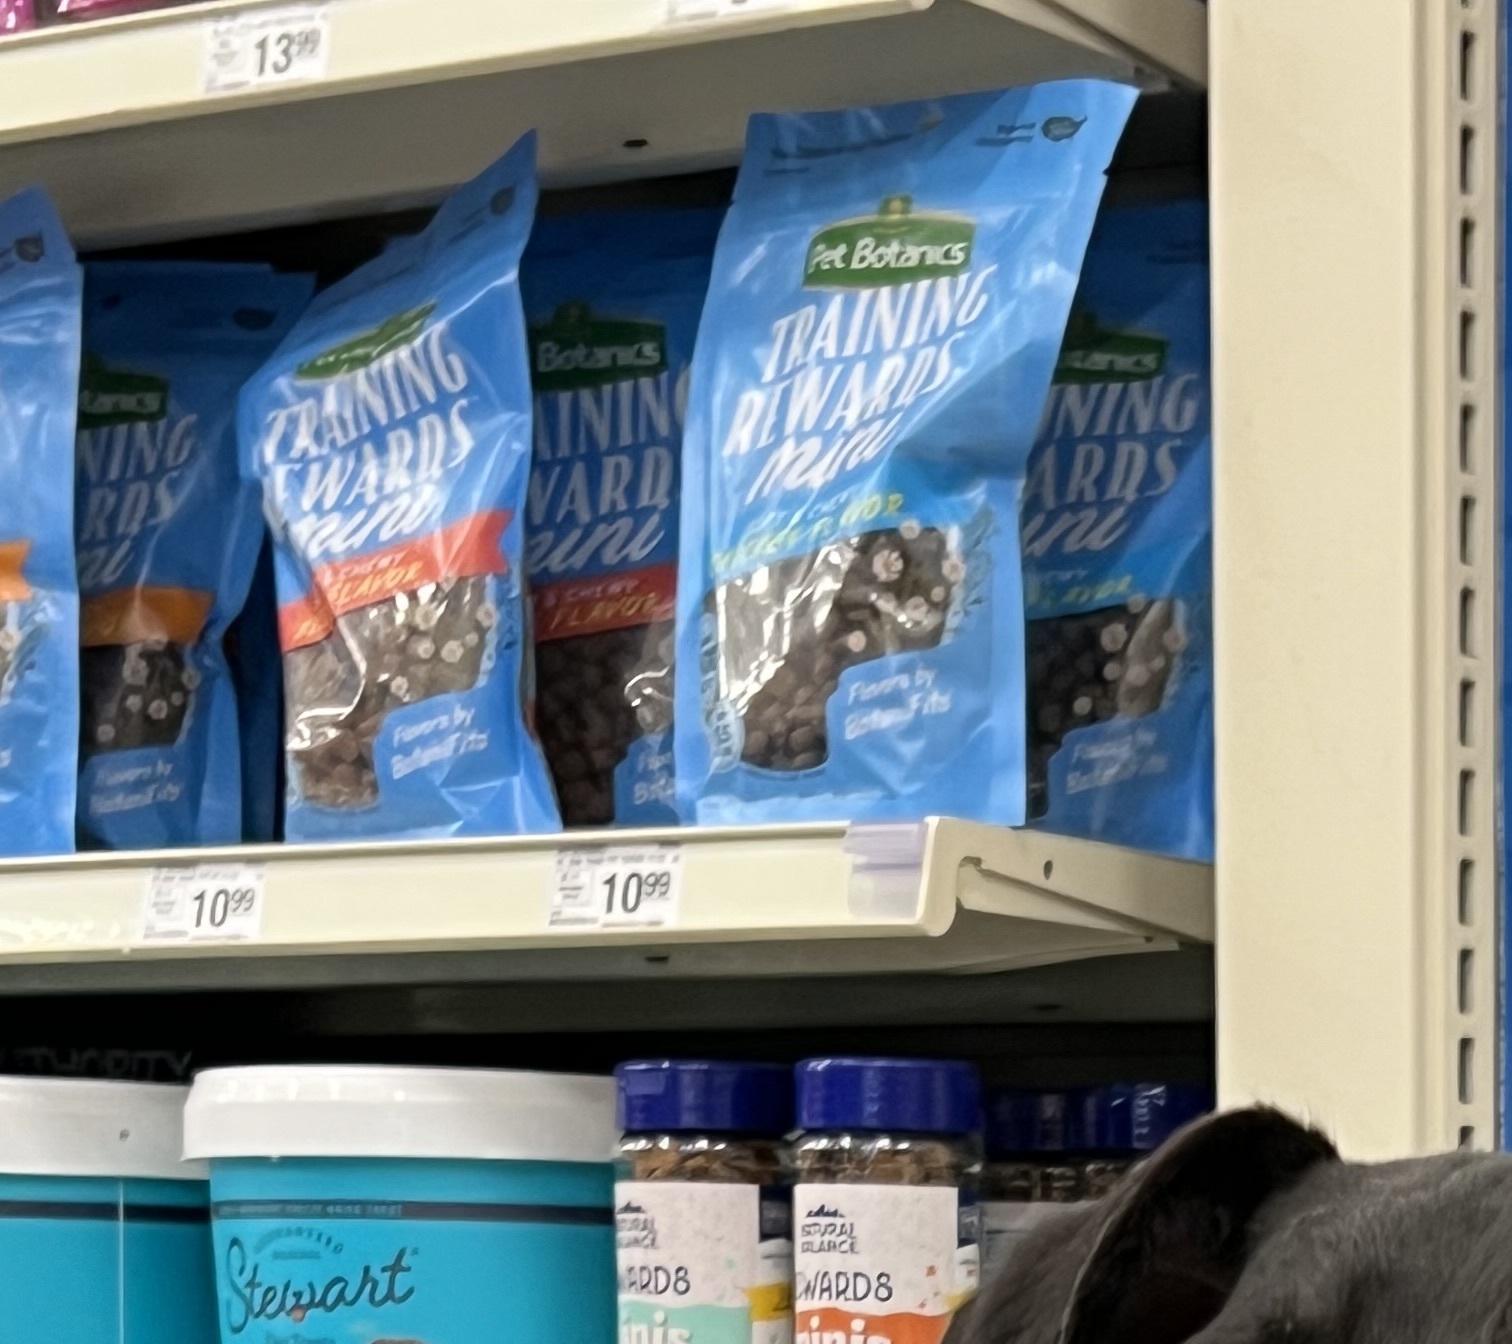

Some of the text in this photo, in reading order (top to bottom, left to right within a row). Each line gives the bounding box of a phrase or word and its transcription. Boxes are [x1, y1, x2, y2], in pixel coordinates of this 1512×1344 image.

[808, 237, 968, 274] Pet Botanics
[761, 263, 997, 383] TRAINING
[264, 321, 468, 464] TRAINING
[721, 331, 966, 457] REWARDS
[227, 1236, 415, 1335] Stewart
